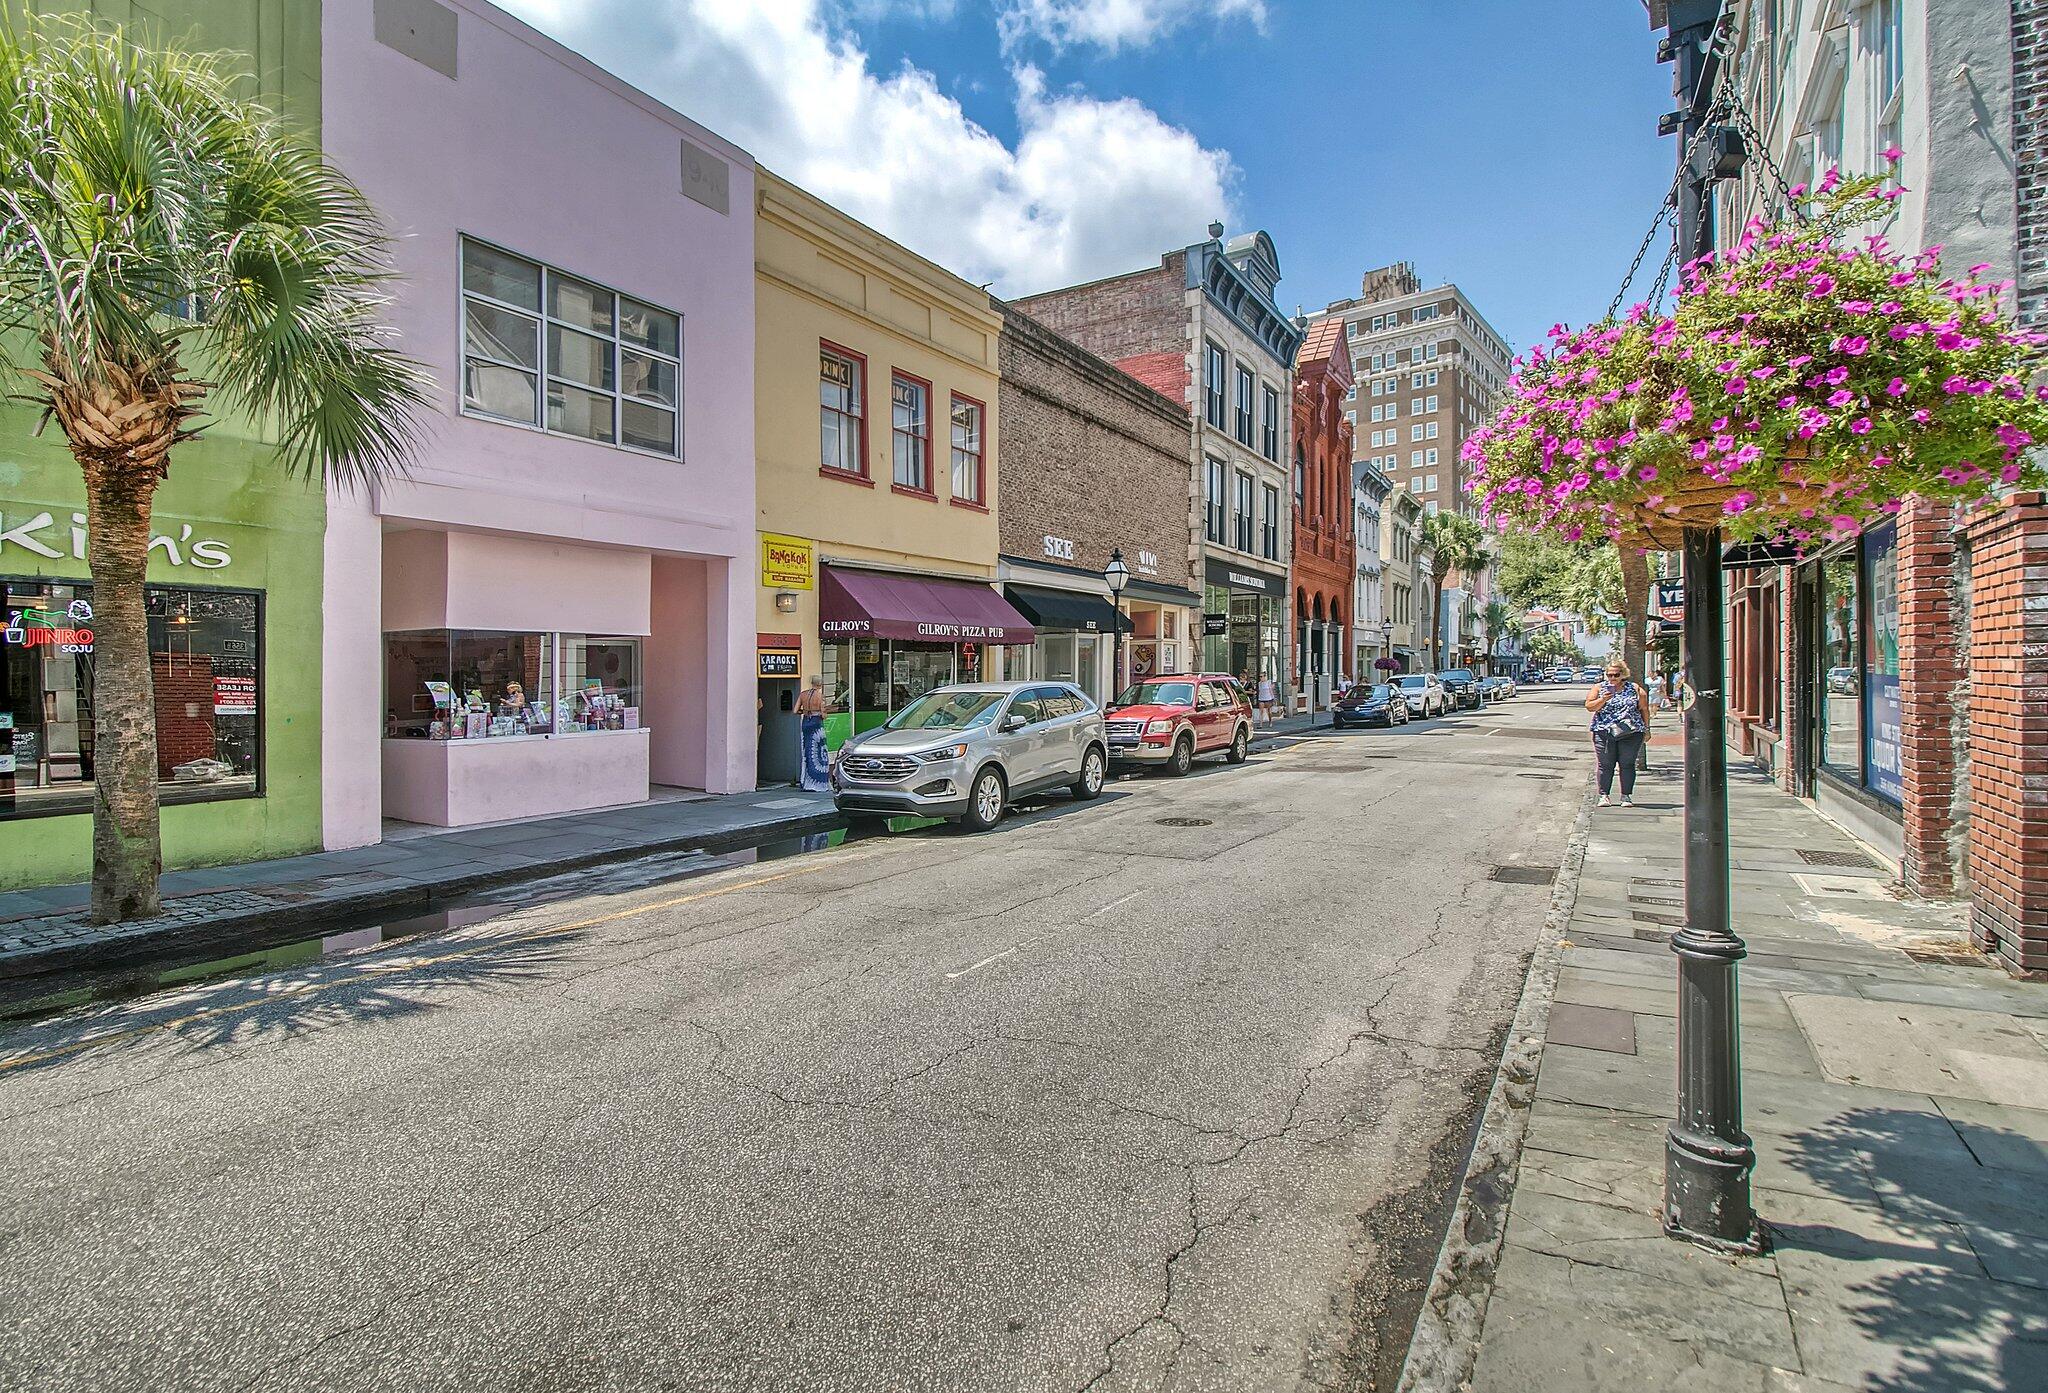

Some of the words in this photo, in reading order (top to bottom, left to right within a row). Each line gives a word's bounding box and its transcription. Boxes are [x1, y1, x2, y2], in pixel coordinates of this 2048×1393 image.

[1043, 535, 1074, 560] SEE
[770, 549, 807, 565] BANGKOK
[1661, 589, 1684, 603] YE
[822, 620, 870, 632] GILROY'S
[918, 622, 959, 637] GILROY'S
[961, 625, 986, 638] PIZZA
[988, 627, 1004, 638] PUB
[1086, 621, 1097, 629] SEE
[23, 628, 94, 649] JINRO
[61, 644, 94, 653] SOJU
[760, 655, 796, 665] KARAOKE
